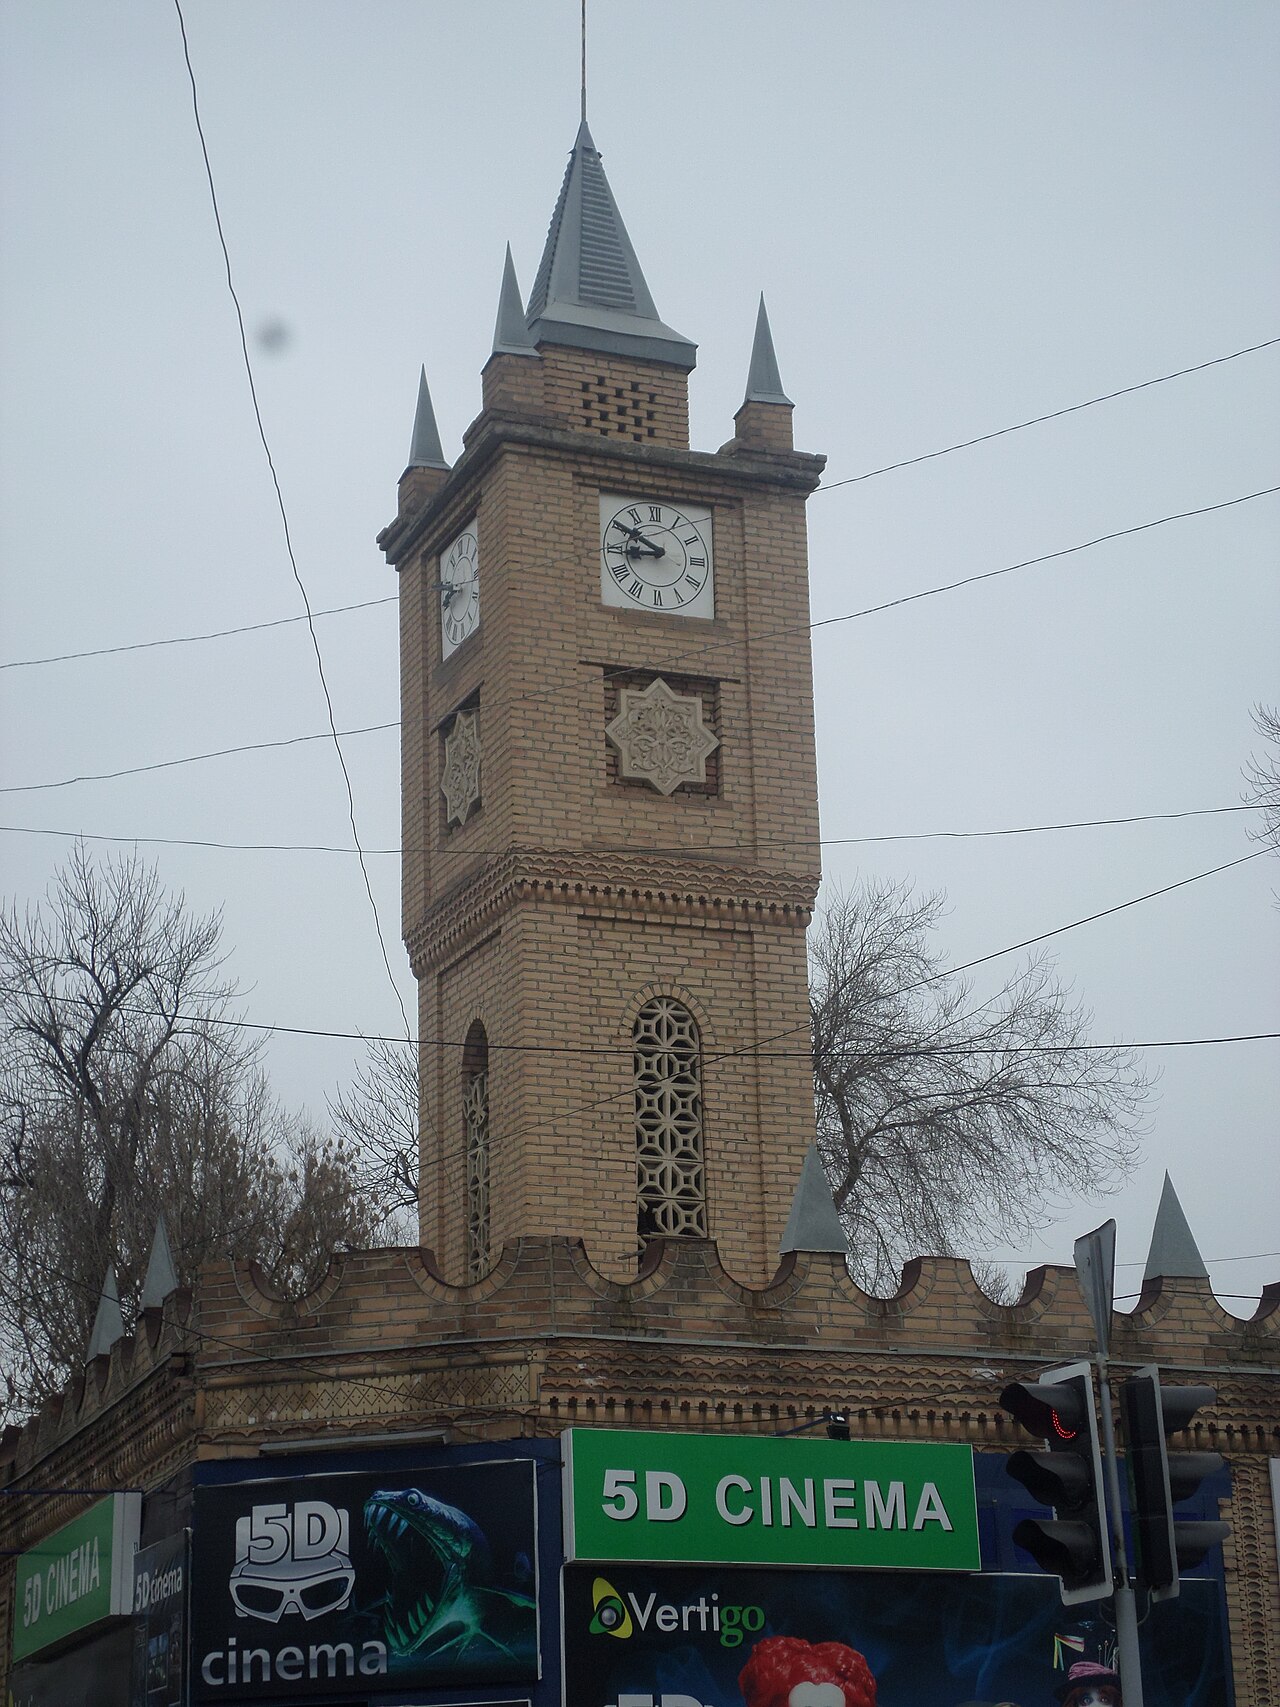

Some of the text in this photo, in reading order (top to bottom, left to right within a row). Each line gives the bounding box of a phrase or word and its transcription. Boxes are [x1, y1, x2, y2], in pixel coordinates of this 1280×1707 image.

[601, 1469, 954, 1532] 5D CINEMA
[248, 1500, 341, 1564] 5D
[23, 1536, 100, 1628] 5D CINEMA
[135, 1565, 183, 1612] 5D cinema
[627, 1592, 766, 1648] Vertigo
[201, 1636, 388, 1686] cinema
